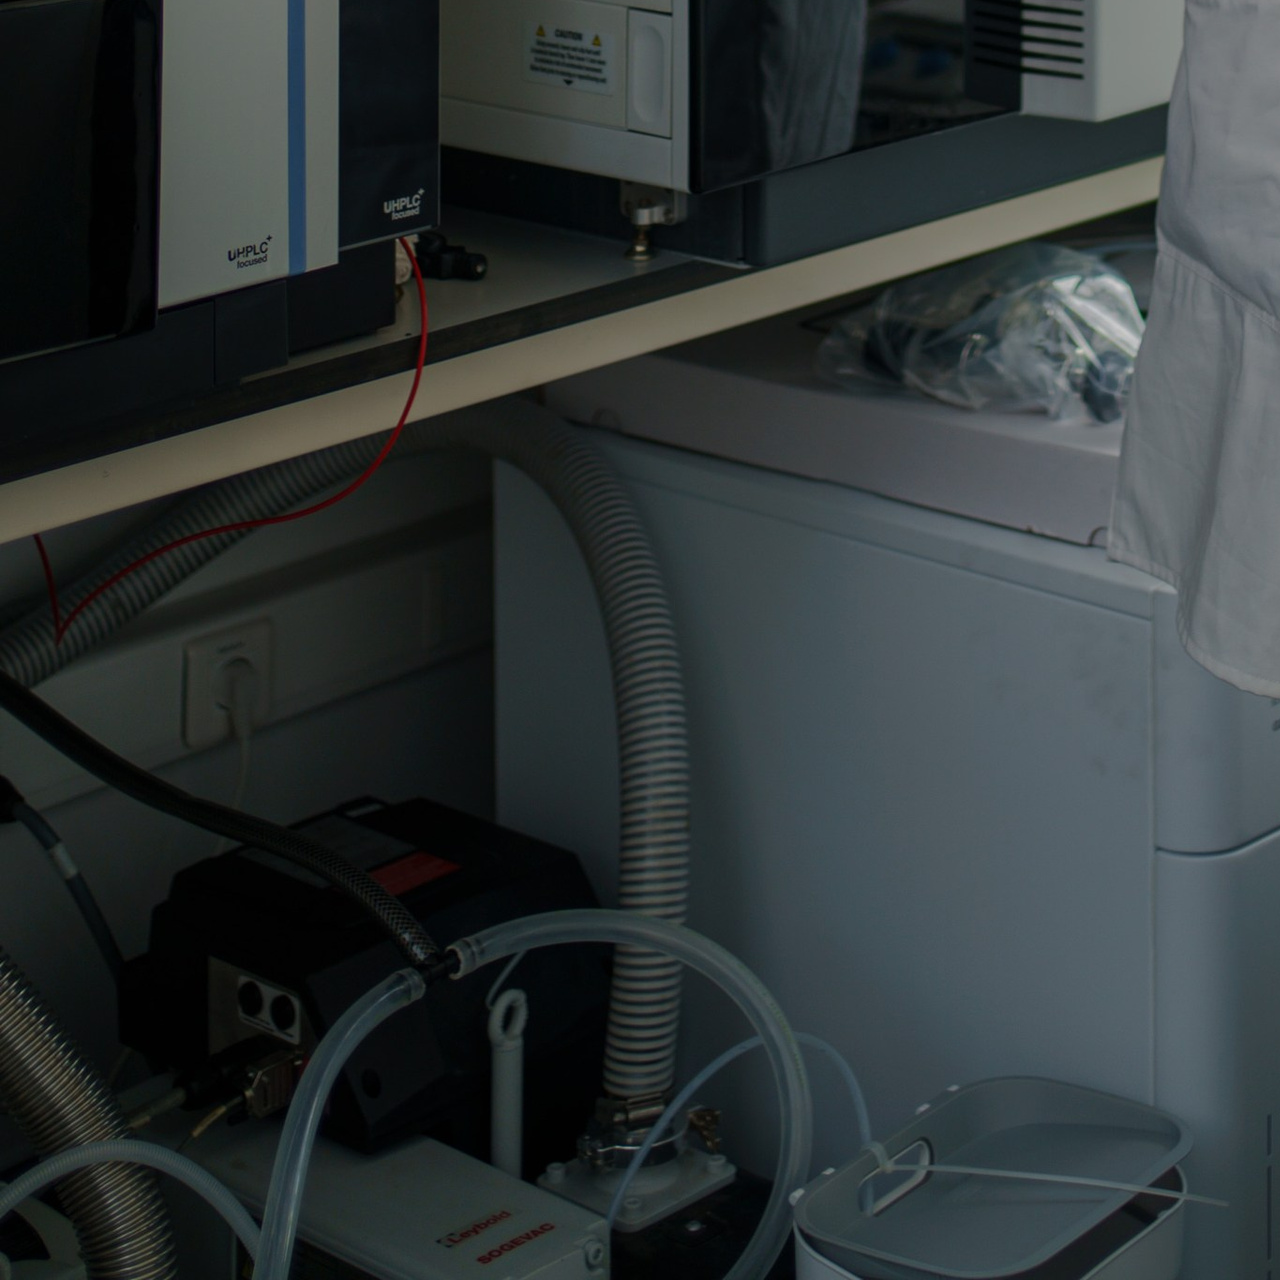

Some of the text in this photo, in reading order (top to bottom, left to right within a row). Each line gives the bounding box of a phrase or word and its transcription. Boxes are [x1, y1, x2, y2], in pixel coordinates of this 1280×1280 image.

[237, 254, 268, 269] focused
[447, 1210, 512, 1244] Leybold
[477, 1223, 556, 1264] SOGEVAC
